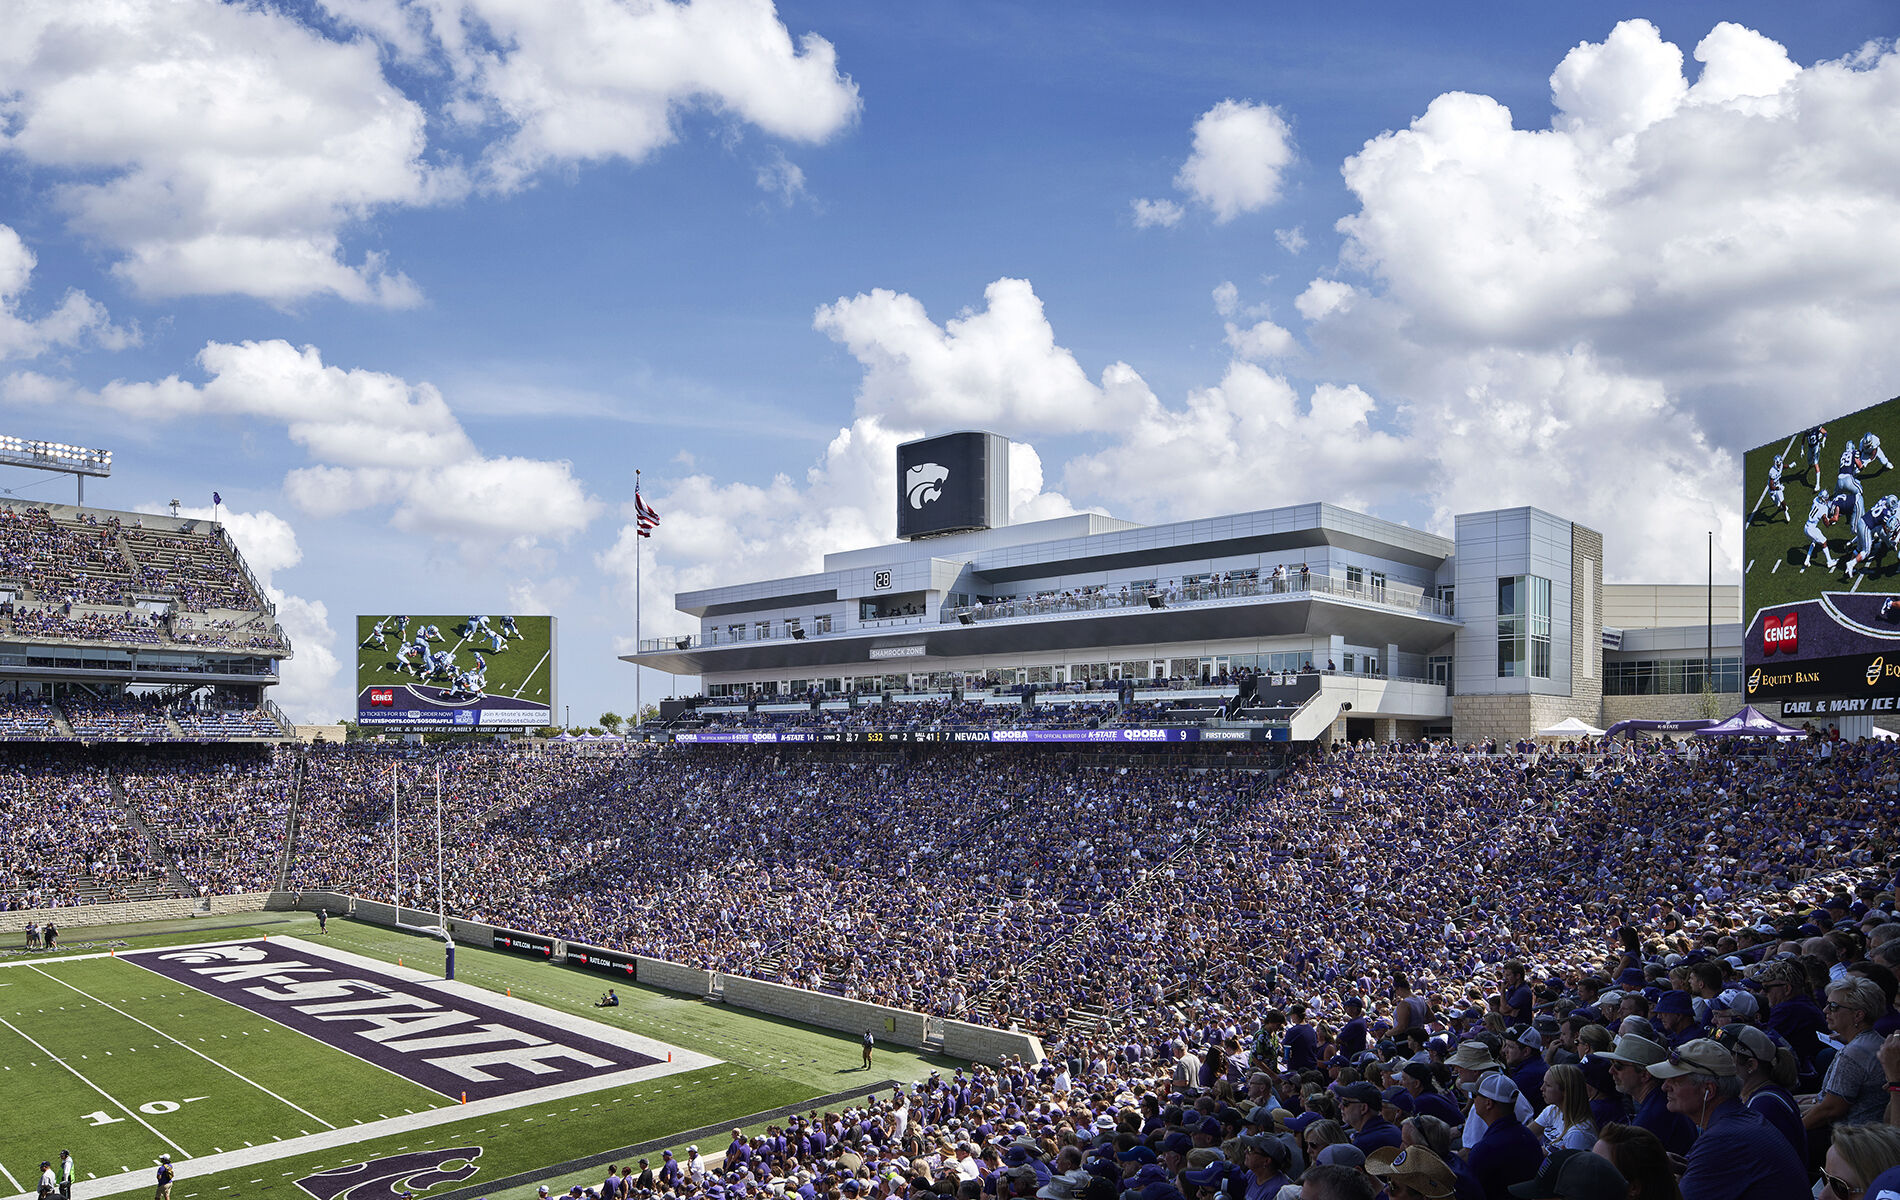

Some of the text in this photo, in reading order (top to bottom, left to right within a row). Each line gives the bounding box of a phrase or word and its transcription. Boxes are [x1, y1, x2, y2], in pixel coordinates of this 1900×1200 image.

[876, 573, 889, 587] 28
[1764, 624, 1796, 642] CENEX
[872, 647, 923, 658] SHAMROCK ZONE
[1762, 672, 1820, 687] EQUITY BANK
[1784, 701, 1812, 714] CARL
[1816, 700, 1826, 712] &
[1830, 698, 1869, 712] MARY
[1872, 698, 1894, 710] ICE
[868, 733, 883, 742] 5:32
[945, 732, 990, 740] 7 NEVADA
[992, 731, 1028, 740] QDOBA
[1124, 730, 1166, 740] QDOBA
[1180, 730, 1187, 740] 9
[1265, 729, 1272, 740] 4
[512, 940, 530, 949] RATE.COM
[590, 956, 610, 967] RATE.COM
[190, 961, 617, 1083] K-STATE
